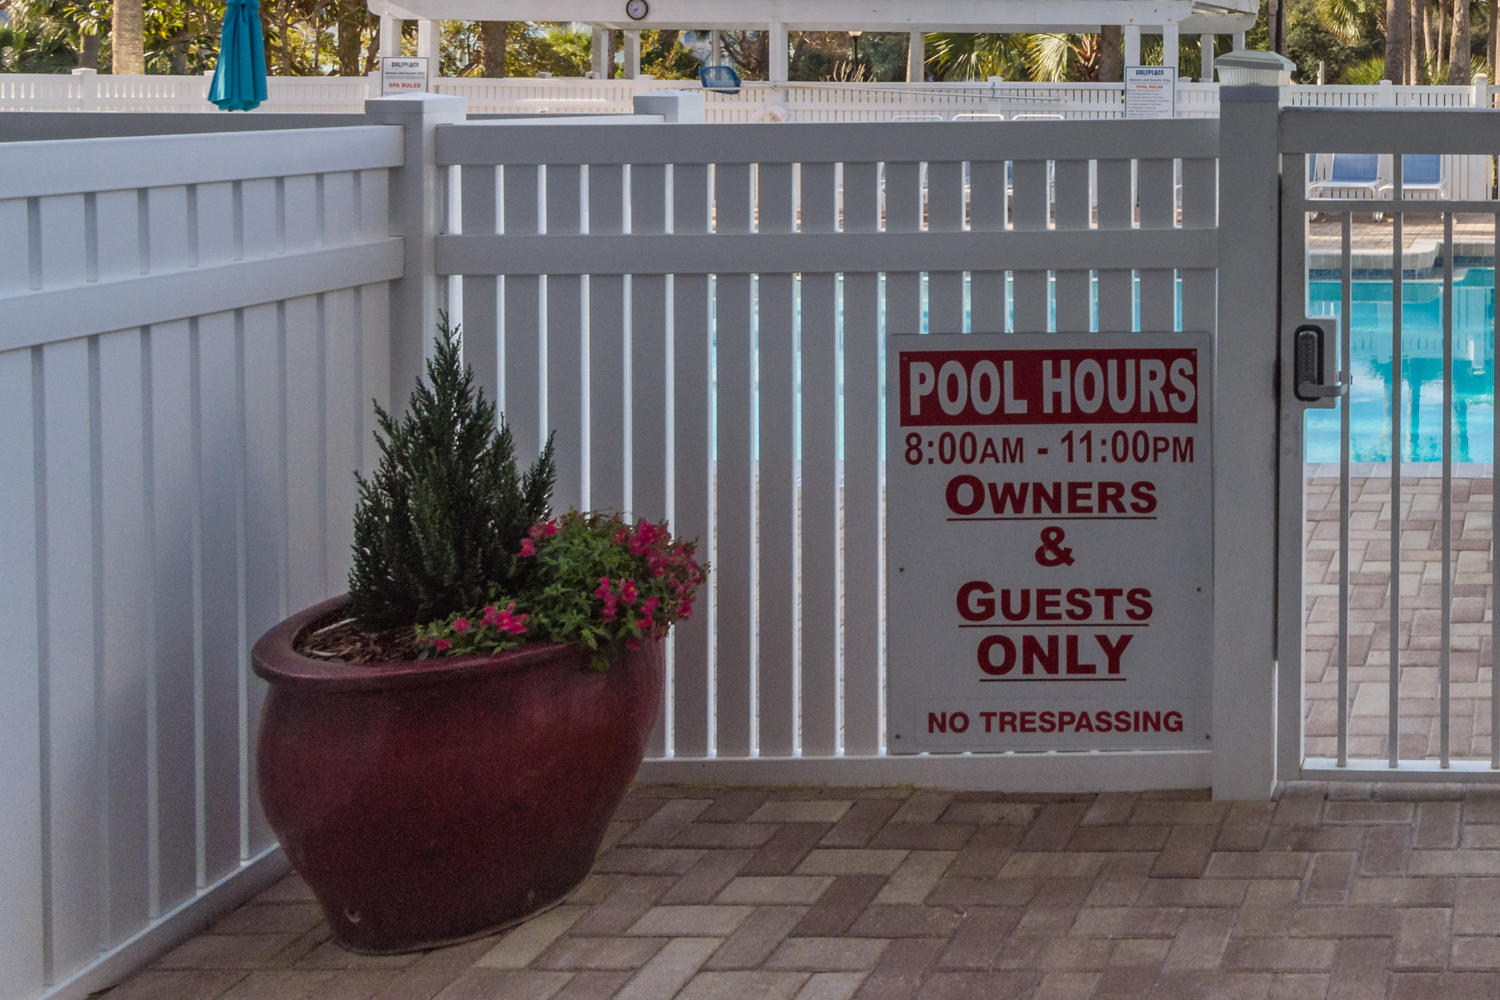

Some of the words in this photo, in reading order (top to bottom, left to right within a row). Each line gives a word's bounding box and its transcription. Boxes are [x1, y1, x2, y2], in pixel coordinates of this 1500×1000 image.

[909, 360, 1028, 415] POOL
[1042, 358, 1197, 414] HOURS
[904, 432, 1024, 465] 8:00AM
[1060, 430, 1194, 463] 11:00PM
[945, 474, 1158, 515] OWNERS
[1034, 526, 1075, 567] &
[956, 580, 1153, 622] GUESTS
[976, 634, 1134, 675] ONLY
[927, 712, 970, 733] NO
[979, 710, 1184, 733] TRESPASSING
